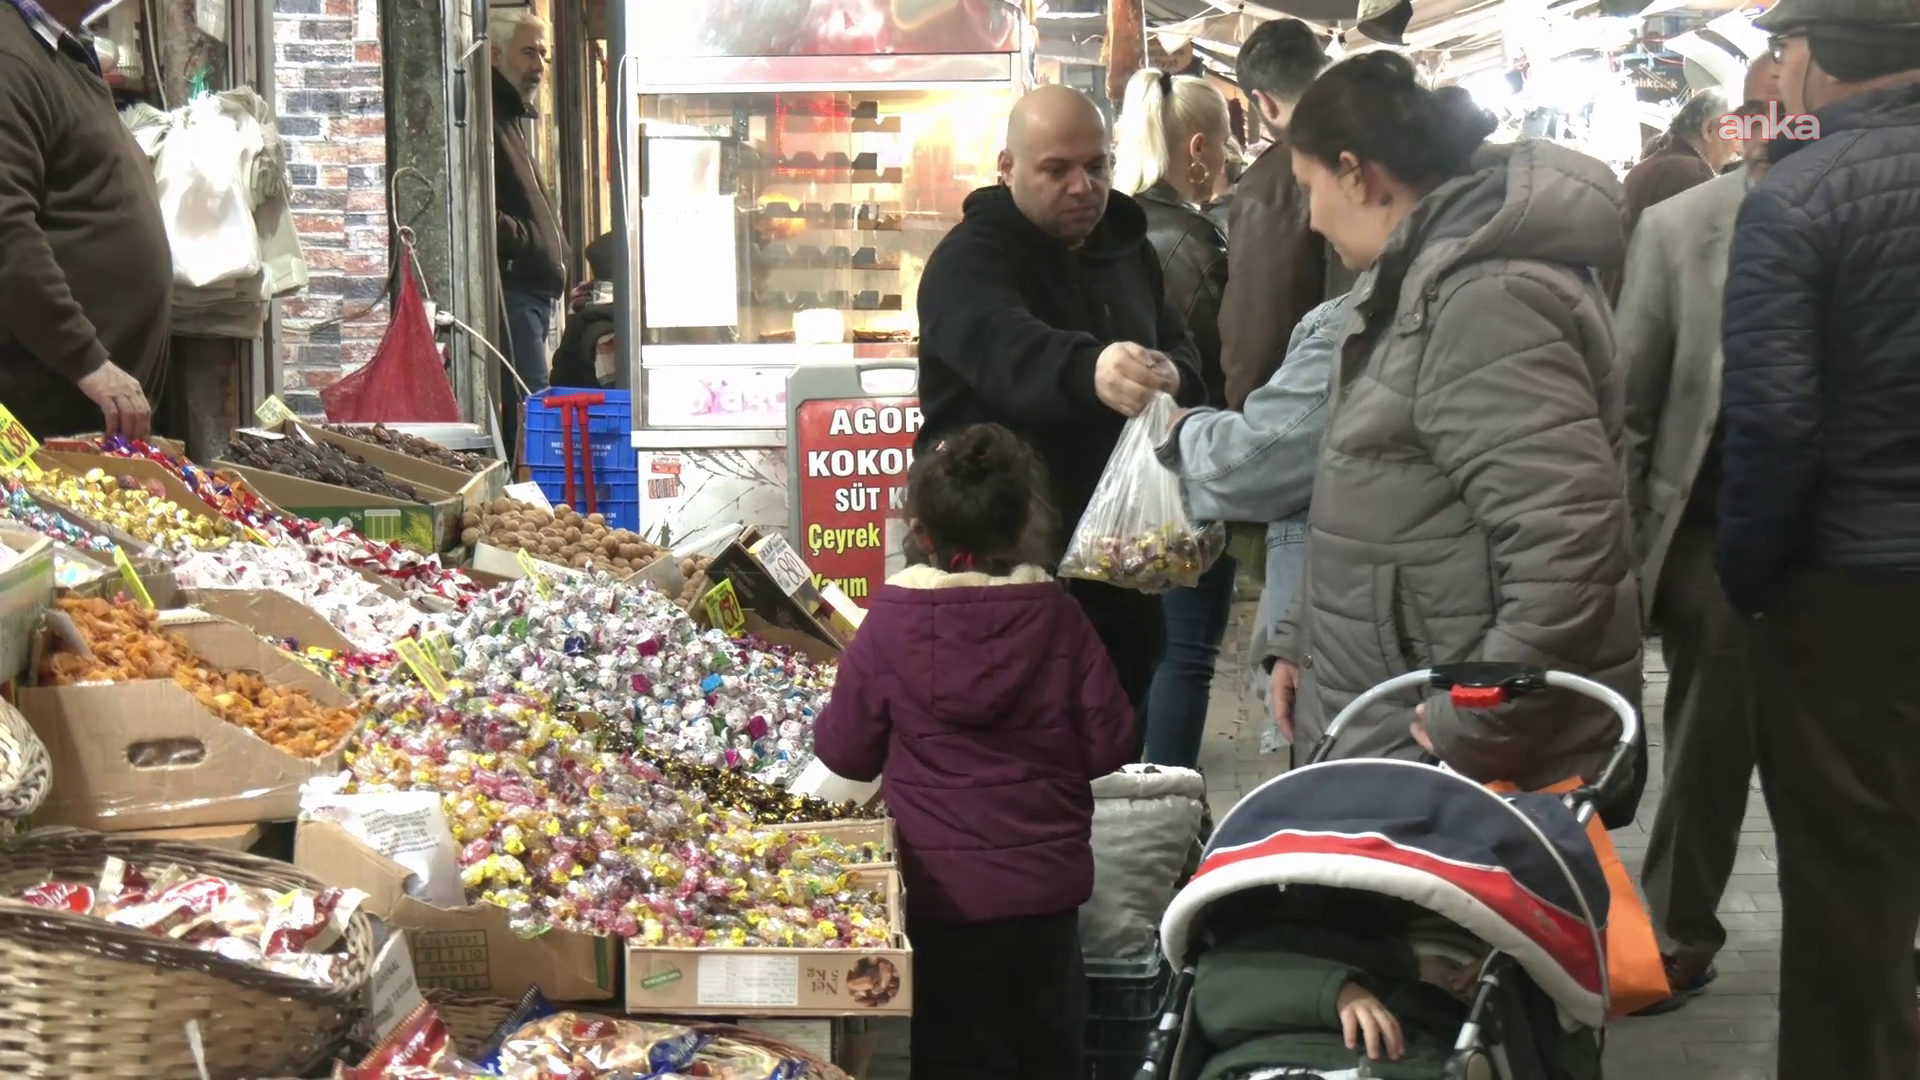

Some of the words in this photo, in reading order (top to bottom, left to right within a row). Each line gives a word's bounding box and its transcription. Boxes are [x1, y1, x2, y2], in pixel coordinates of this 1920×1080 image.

[835, 482, 881, 512] SÜT
[889, 487, 909, 510] K
[808, 522, 881, 557] Çeyrek
[811, 980, 839, 995] Net
